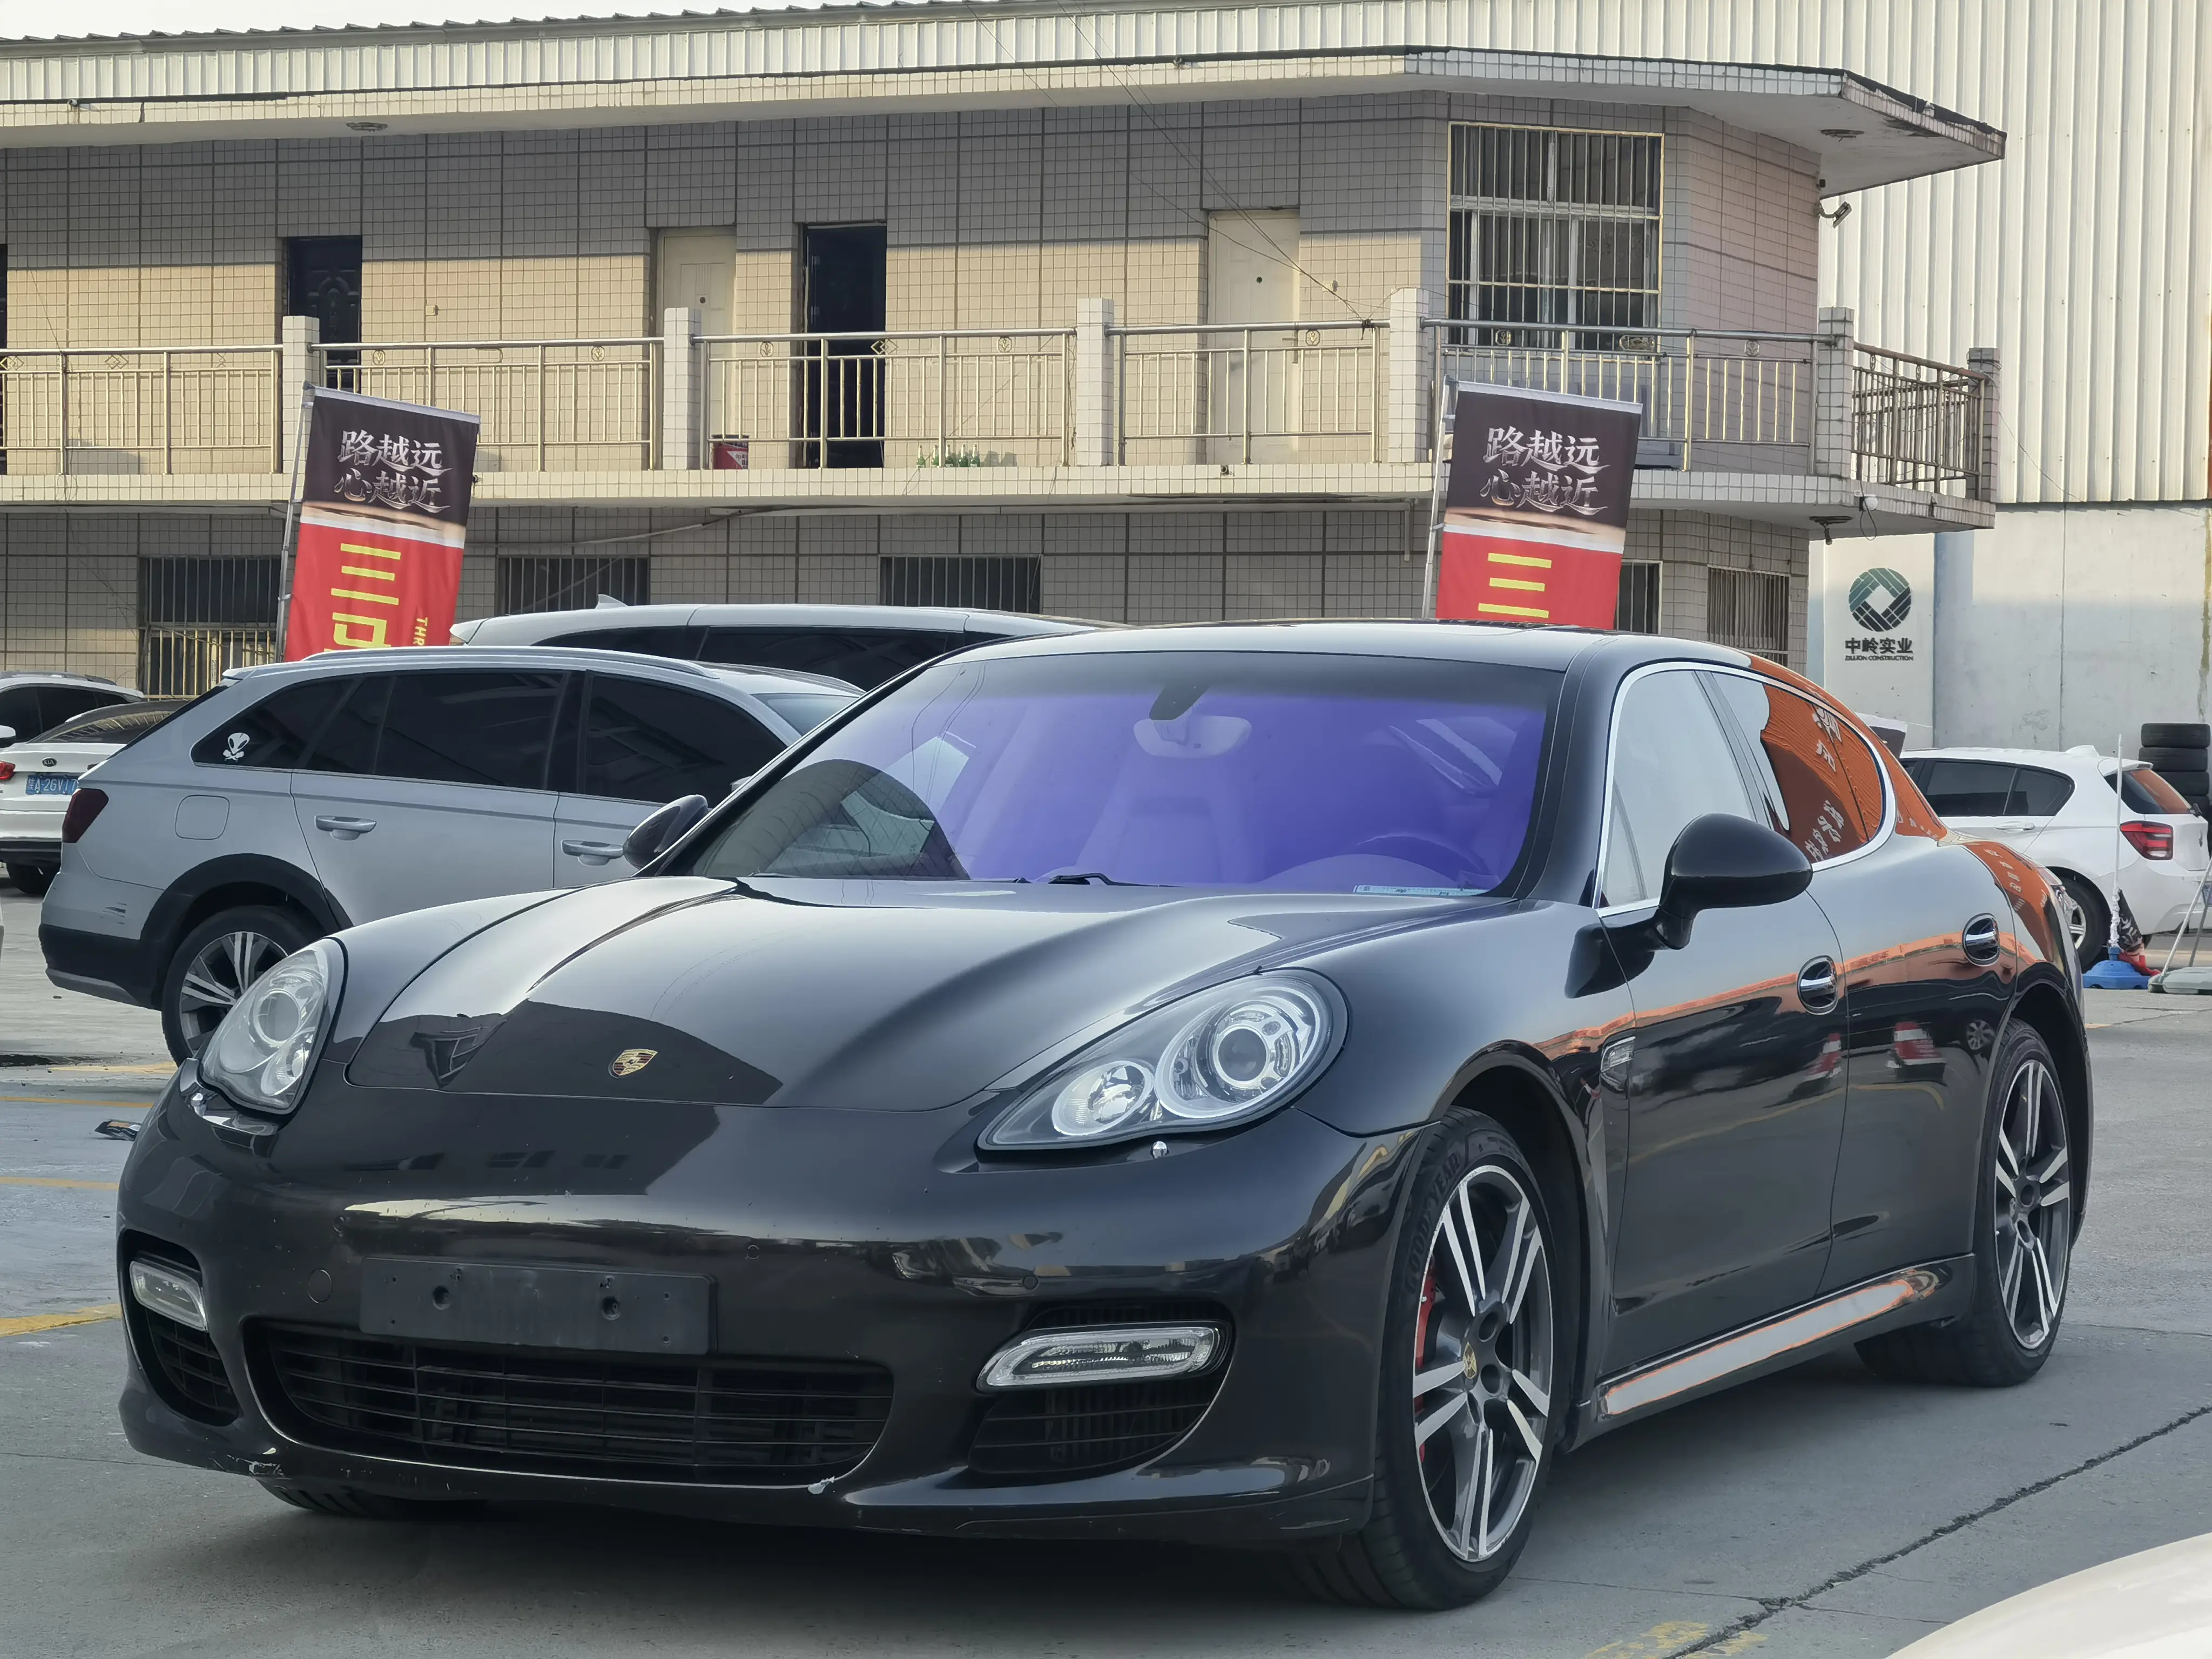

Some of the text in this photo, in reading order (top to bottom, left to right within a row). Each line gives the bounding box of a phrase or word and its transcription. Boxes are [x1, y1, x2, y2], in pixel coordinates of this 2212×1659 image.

[337, 430, 453, 476] 路越远
[1483, 426, 1611, 474] 路越远
[334, 468, 450, 513] 心越近
[1480, 469, 1609, 516] 心越近
[1478, 552, 1552, 618] 三
[1845, 637, 1913, 654] 中岭实业
[1407, 1152, 1461, 1295] GOODYEAR
